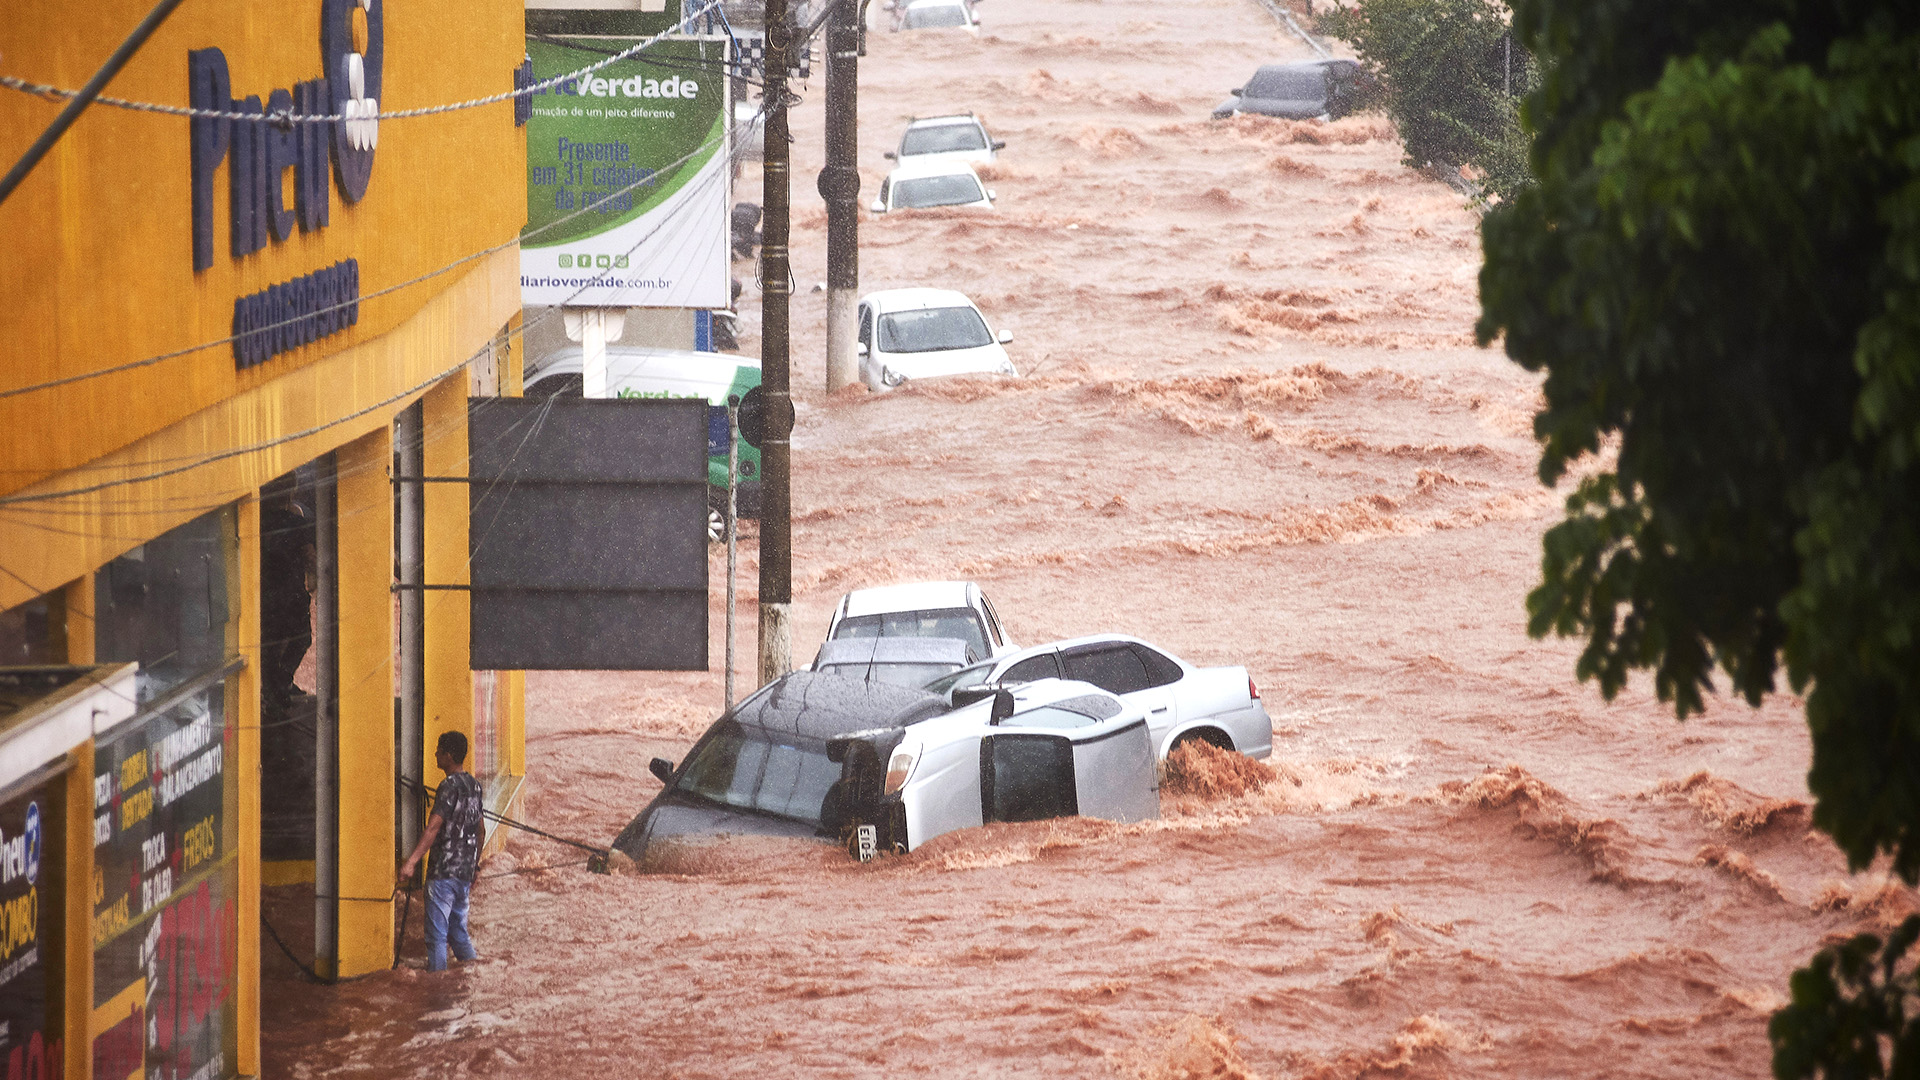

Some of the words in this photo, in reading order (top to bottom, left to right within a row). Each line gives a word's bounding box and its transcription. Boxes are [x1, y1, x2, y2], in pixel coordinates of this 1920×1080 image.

[571, 106, 584, 117] de
[586, 109, 602, 117] um
[604, 107, 628, 119] jeito
[630, 107, 675, 119] diferente
[558, 136, 630, 162] Presente
[532, 165, 557, 186] em
[564, 161, 584, 186] 31
[592, 163, 656, 187] cidades
[555, 186, 574, 210] da
[162, 742, 222, 808] BALANCEAMENTO
[142, 831, 166, 873] TROCA
[183, 813, 215, 873] FREIOS
[142, 877, 153, 914] DE
